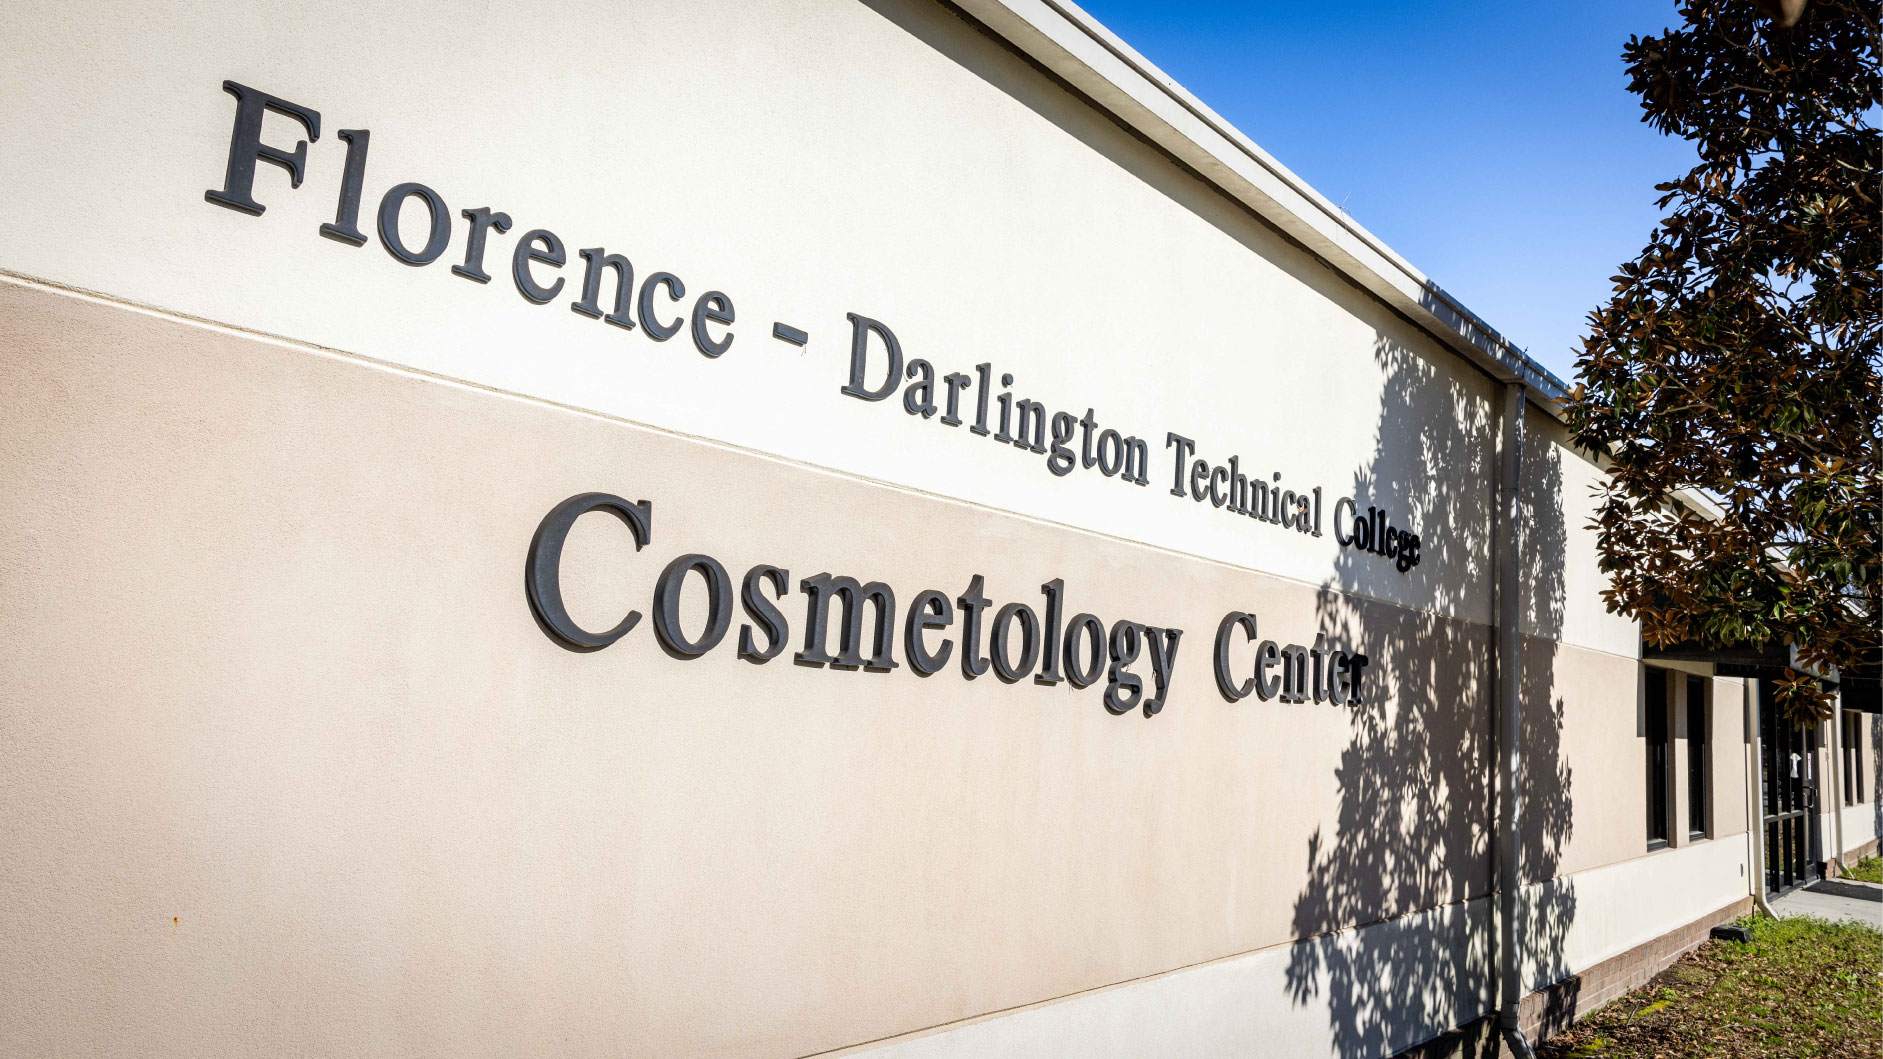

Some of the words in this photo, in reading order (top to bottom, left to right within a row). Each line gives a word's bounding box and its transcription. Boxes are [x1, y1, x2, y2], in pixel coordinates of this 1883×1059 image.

[204, 80, 735, 359] Florence
[772, 321, 809, 347] -
[840, 312, 1149, 486] Darlington
[1166, 432, 1323, 538] Technical
[1334, 497, 1421, 573] College
[525, 492, 1184, 718] Cosmetology
[1213, 611, 1369, 707] Center
